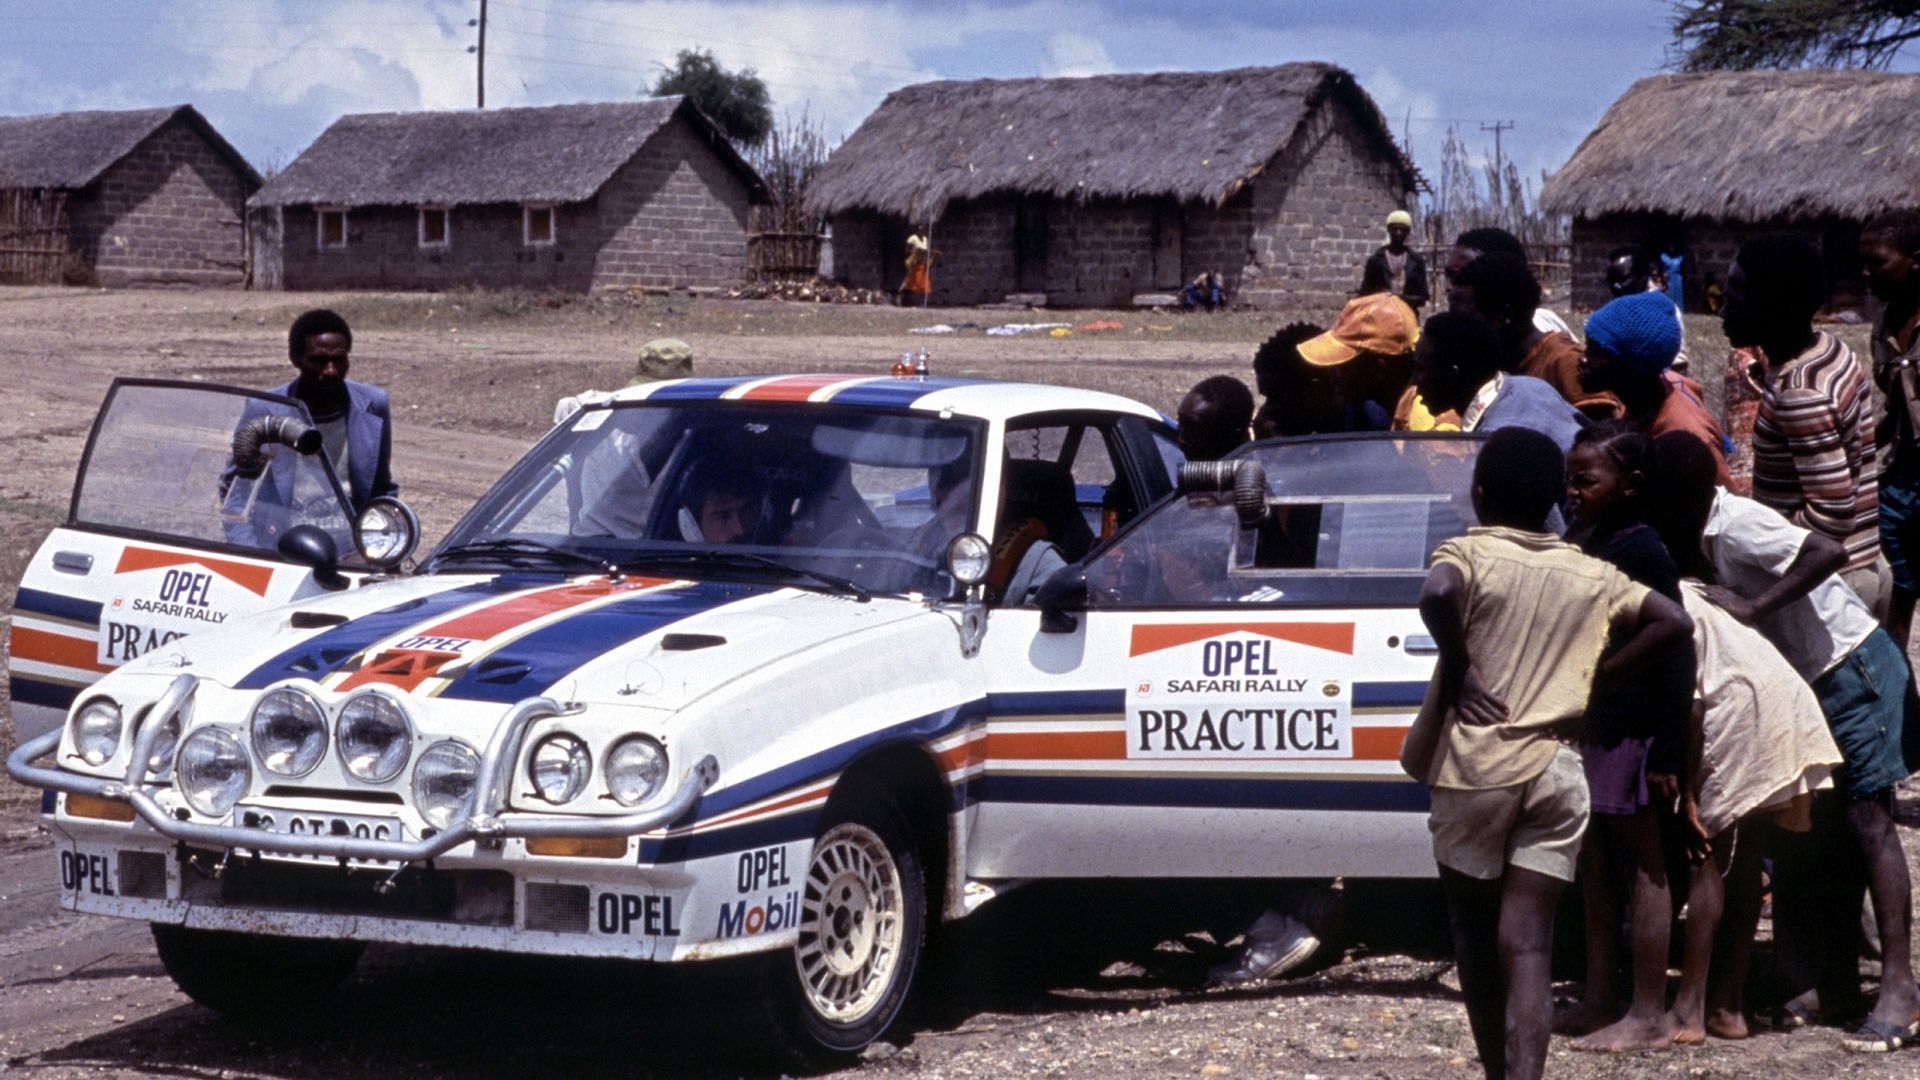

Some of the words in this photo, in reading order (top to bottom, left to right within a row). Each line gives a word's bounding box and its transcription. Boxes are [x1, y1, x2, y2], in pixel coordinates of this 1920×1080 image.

[159, 569, 212, 607] OPEL
[132, 598, 182, 617] SAFARI
[184, 607, 228, 624] RALLY
[395, 637, 471, 652] OPEL
[1202, 640, 1277, 677] OPEL
[1167, 680, 1240, 693] SAFARI
[1245, 679, 1308, 693] RALLY
[1138, 708, 1339, 751] PRACTICE
[61, 850, 114, 896] OPEL
[737, 846, 790, 894] OPEL
[598, 893, 680, 936] OPEL
[716, 891, 799, 938] Mobil
